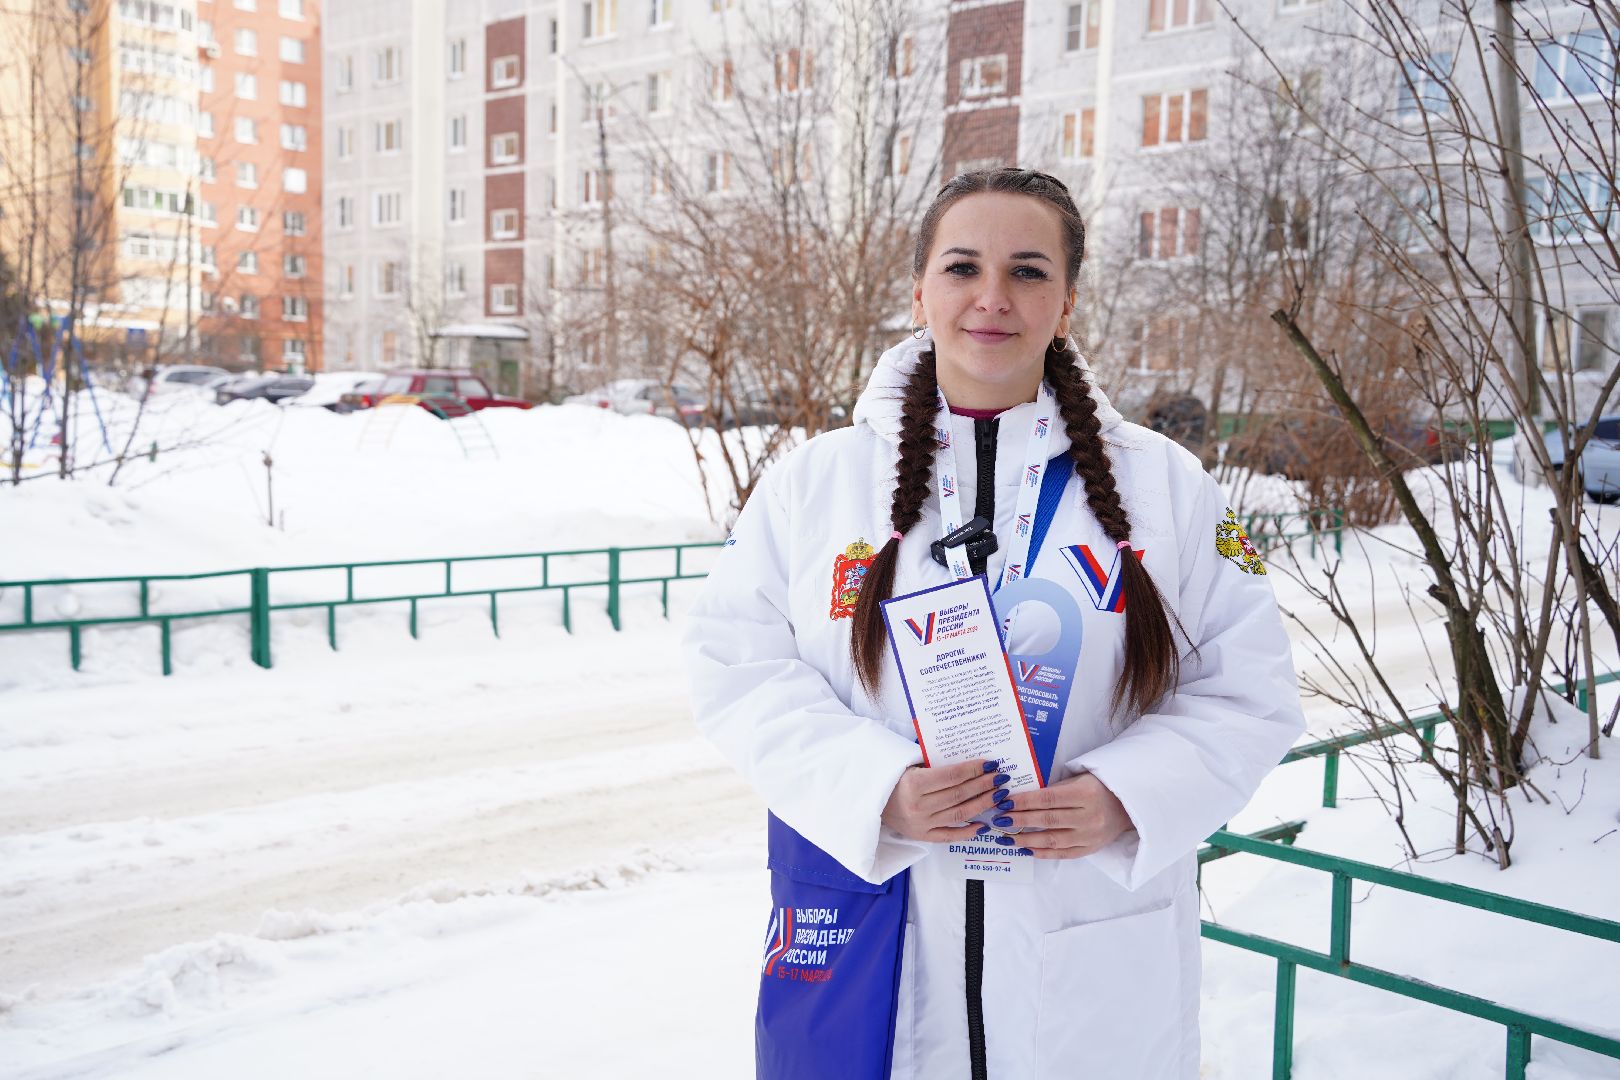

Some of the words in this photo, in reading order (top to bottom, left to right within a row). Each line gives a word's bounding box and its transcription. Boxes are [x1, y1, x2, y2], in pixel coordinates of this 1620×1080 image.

[938, 609, 980, 626] ПРЕЗИДЕНТА
[939, 602, 969, 617] ВЫБОРЫ
[936, 621, 964, 635] РОССИИ
[936, 647, 966, 663] ДОРОГИЕ
[796, 908, 839, 924] ВЫБОРЫ
[780, 948, 828, 965] РОССИИ
